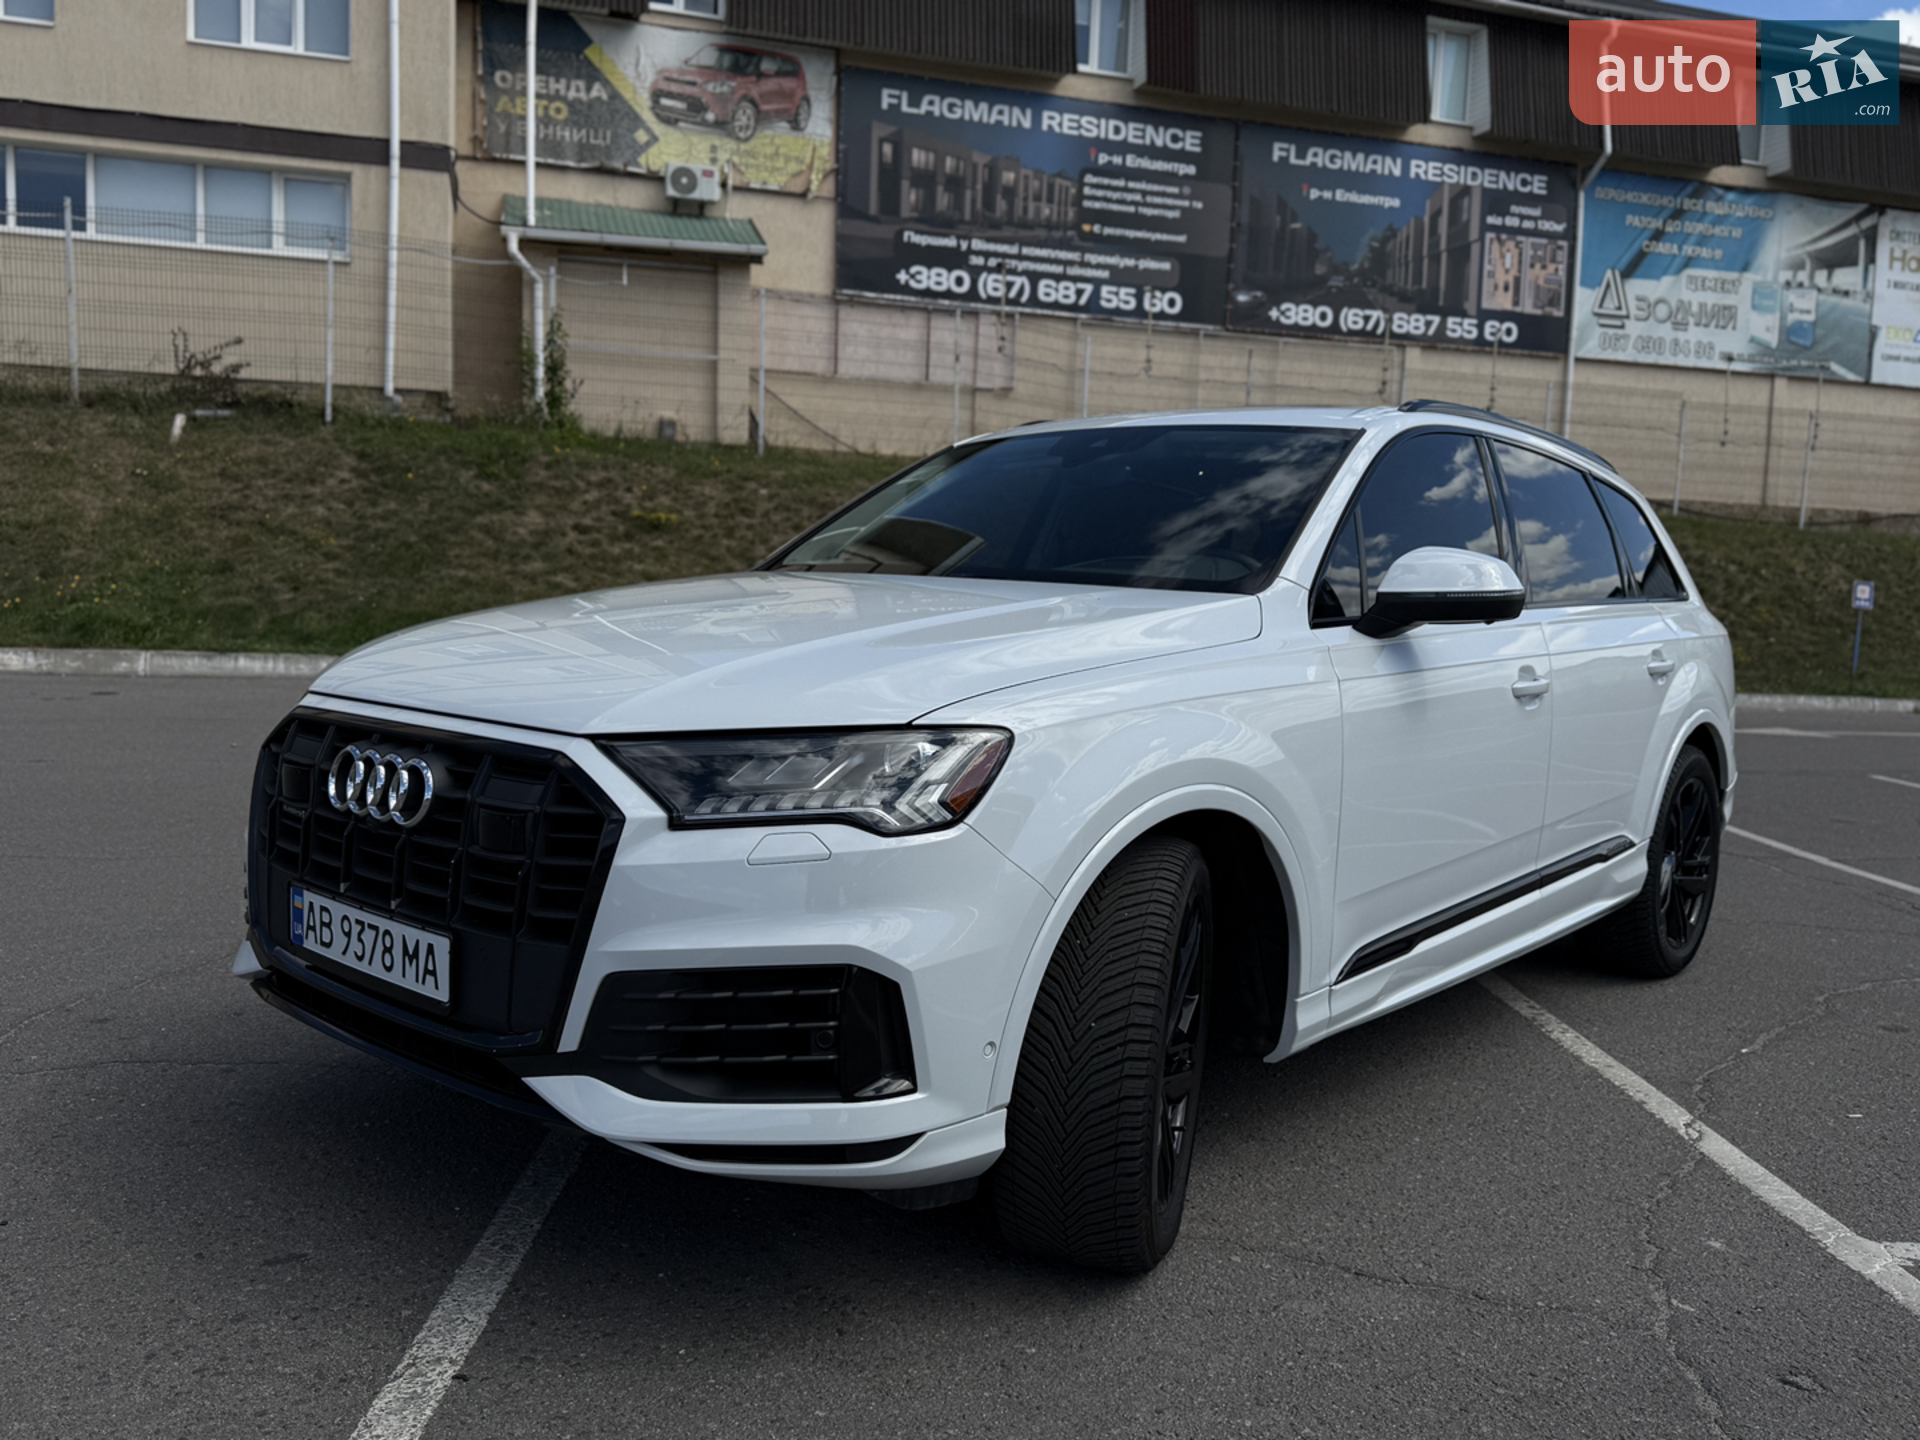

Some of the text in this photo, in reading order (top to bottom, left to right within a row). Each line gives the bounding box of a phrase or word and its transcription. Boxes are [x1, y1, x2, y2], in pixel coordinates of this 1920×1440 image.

[494, 69, 608, 101] ОРЕНДА
[496, 96, 569, 120] АВТО
[881, 88, 1203, 153] FLAGMAN RESIDENCE
[517, 122, 611, 146] ВННИЦІ
[1098, 152, 1123, 165] р-н
[1272, 142, 1549, 195] FLAGMAN RESIDENCE
[1309, 187, 1333, 200] р-н
[1625, 214, 1664, 230] РАЗОМ
[1665, 219, 1682, 234] ДО
[903, 230, 957, 248] Перший
[959, 238, 969, 252] у
[1642, 240, 1680, 256] СЛАВА
[968, 254, 985, 266] за
[895, 264, 1184, 316] +380 (67) 687 55 60
[1686, 274, 1742, 295] ЦЕМЕНТ
[1268, 302, 1519, 343] +380 (67) 687 55 60
[1634, 294, 1738, 332] ЗОДЧИЙ
[305, 900, 439, 991] AB 9378 MA
